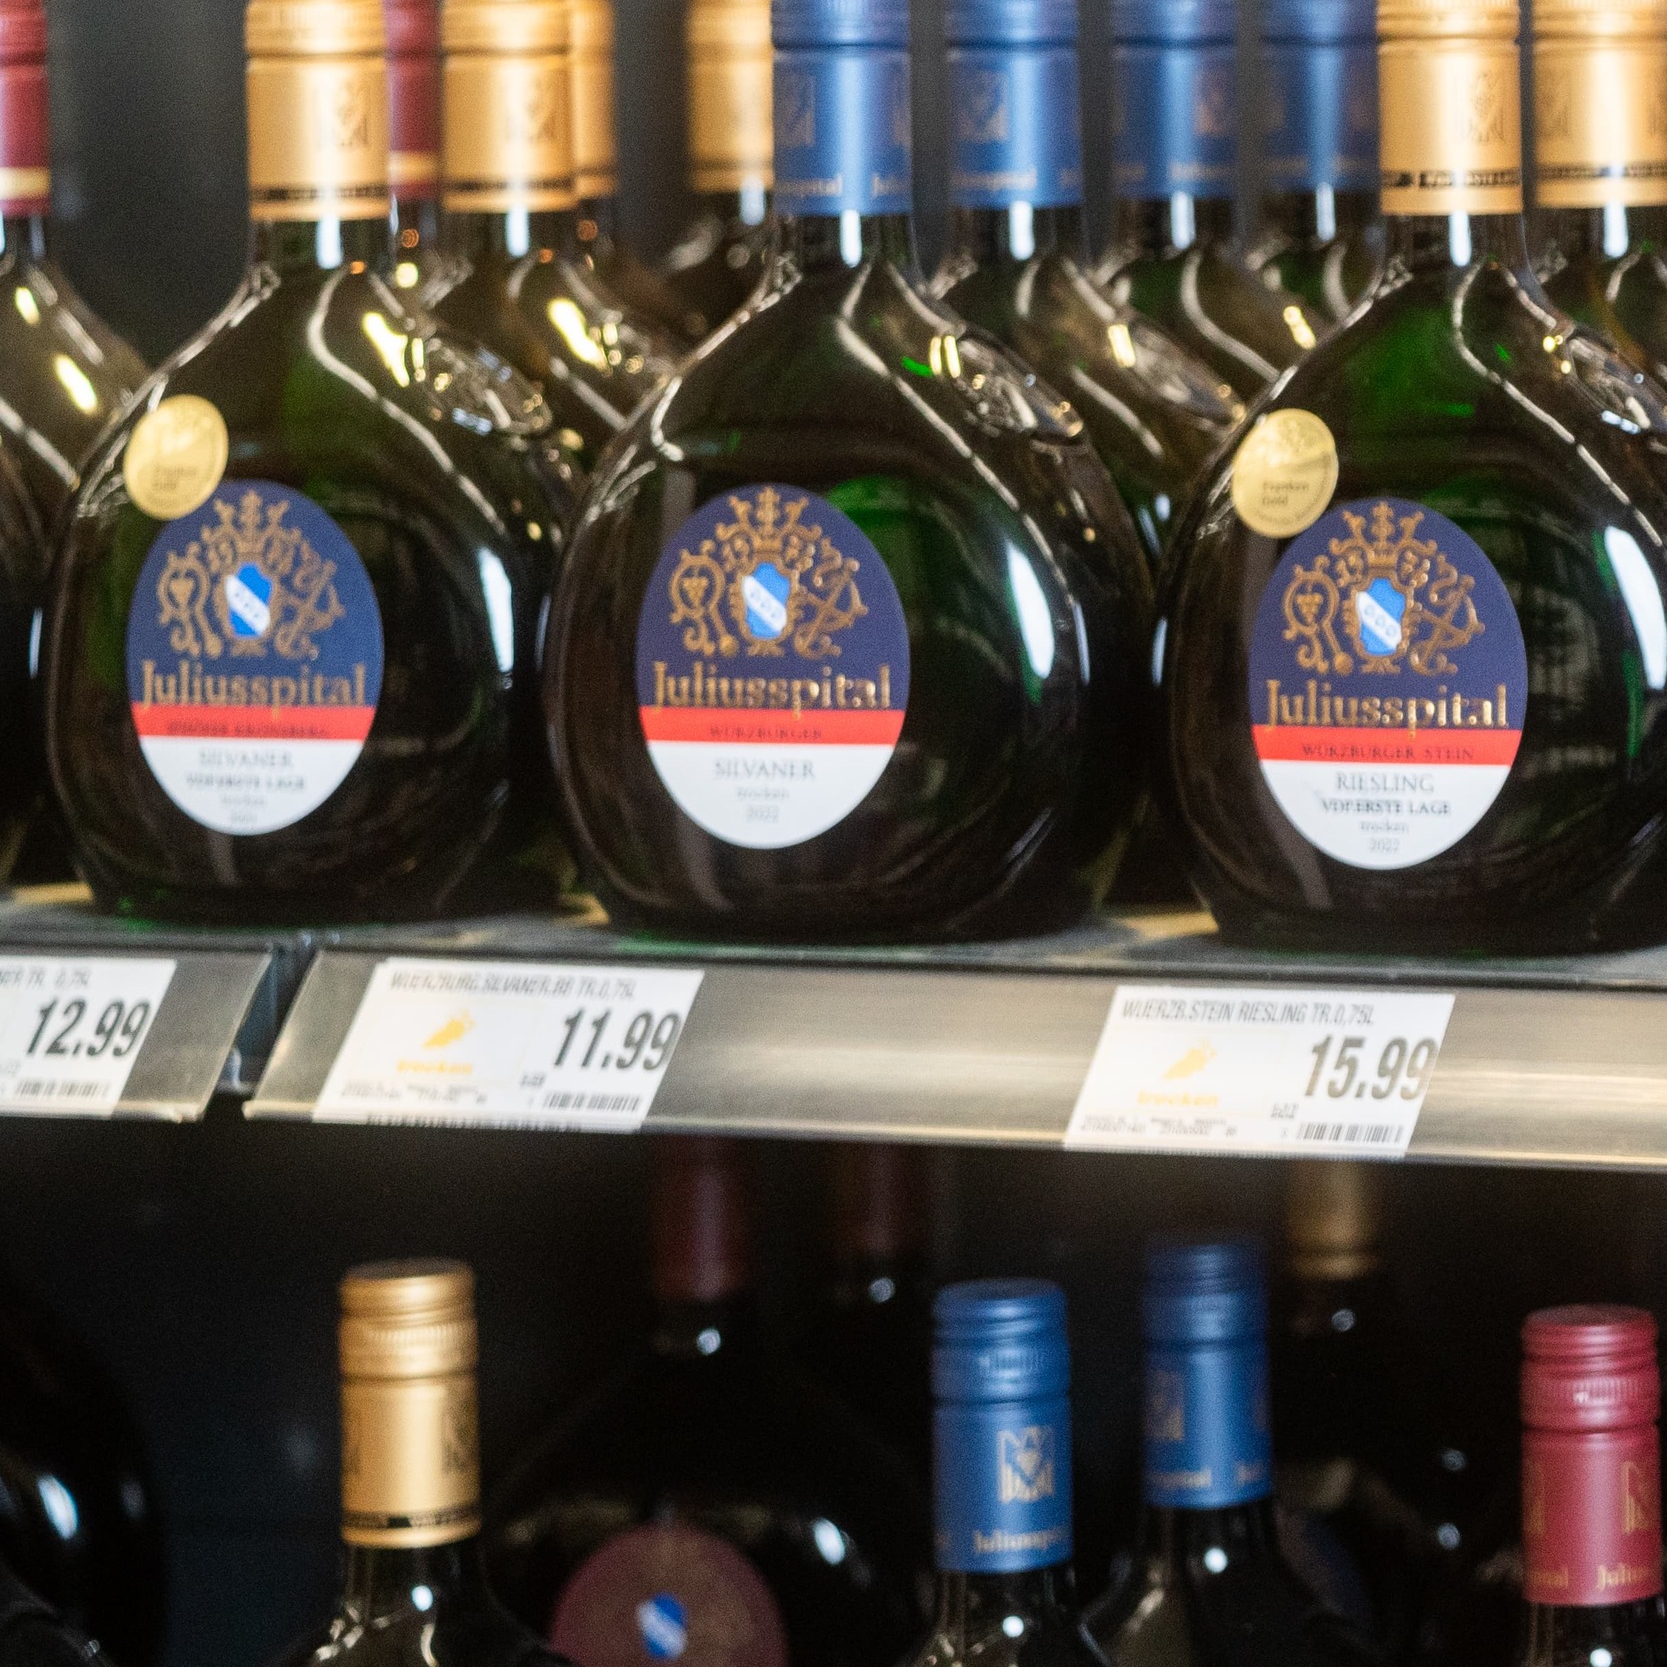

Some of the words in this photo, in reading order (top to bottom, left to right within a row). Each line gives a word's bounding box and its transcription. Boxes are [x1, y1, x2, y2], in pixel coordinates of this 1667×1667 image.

[142, 659, 366, 720] Juliusspital
[652, 661, 891, 719] Juliusspital
[1264, 679, 1509, 739] Juliusspital
[714, 758, 815, 779] SILVANER
[1336, 772, 1434, 793] RIESLING
[27, 997, 151, 1057] 12.99
[554, 1007, 683, 1072] 11.99
[1238, 1000, 1306, 1025] RIESLING
[1304, 1034, 1441, 1102] 15.99
